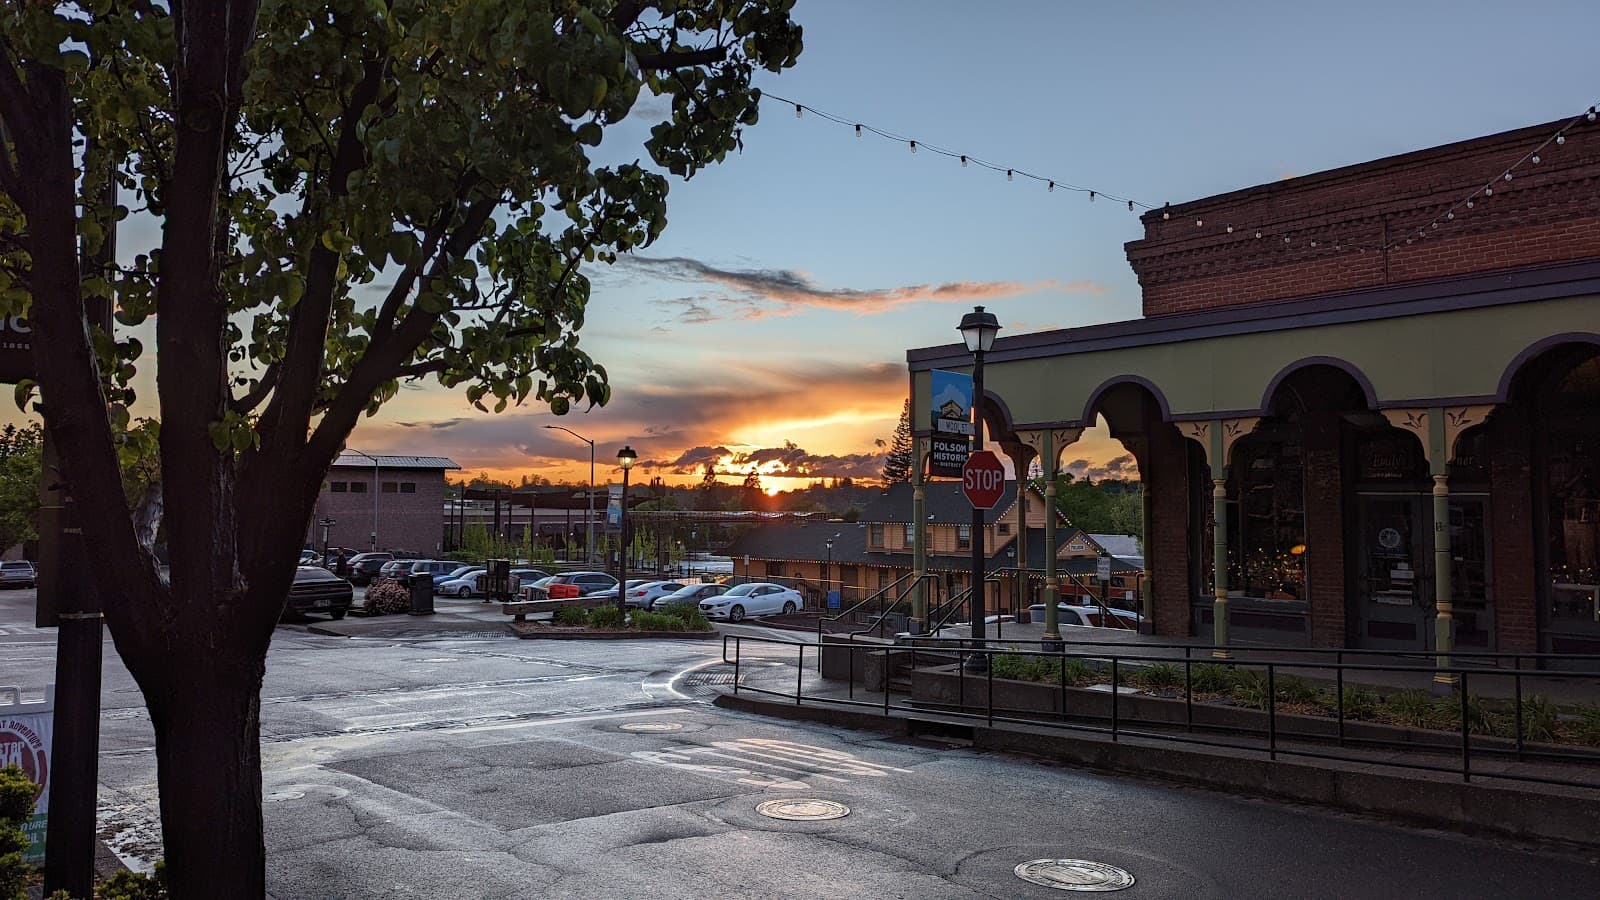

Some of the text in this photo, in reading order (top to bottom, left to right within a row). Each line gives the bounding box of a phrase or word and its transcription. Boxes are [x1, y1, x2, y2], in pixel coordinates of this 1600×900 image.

[933, 442, 967, 452] FOLSOM
[933, 452, 968, 462] HISTORIC
[966, 469, 1002, 490] STOP
